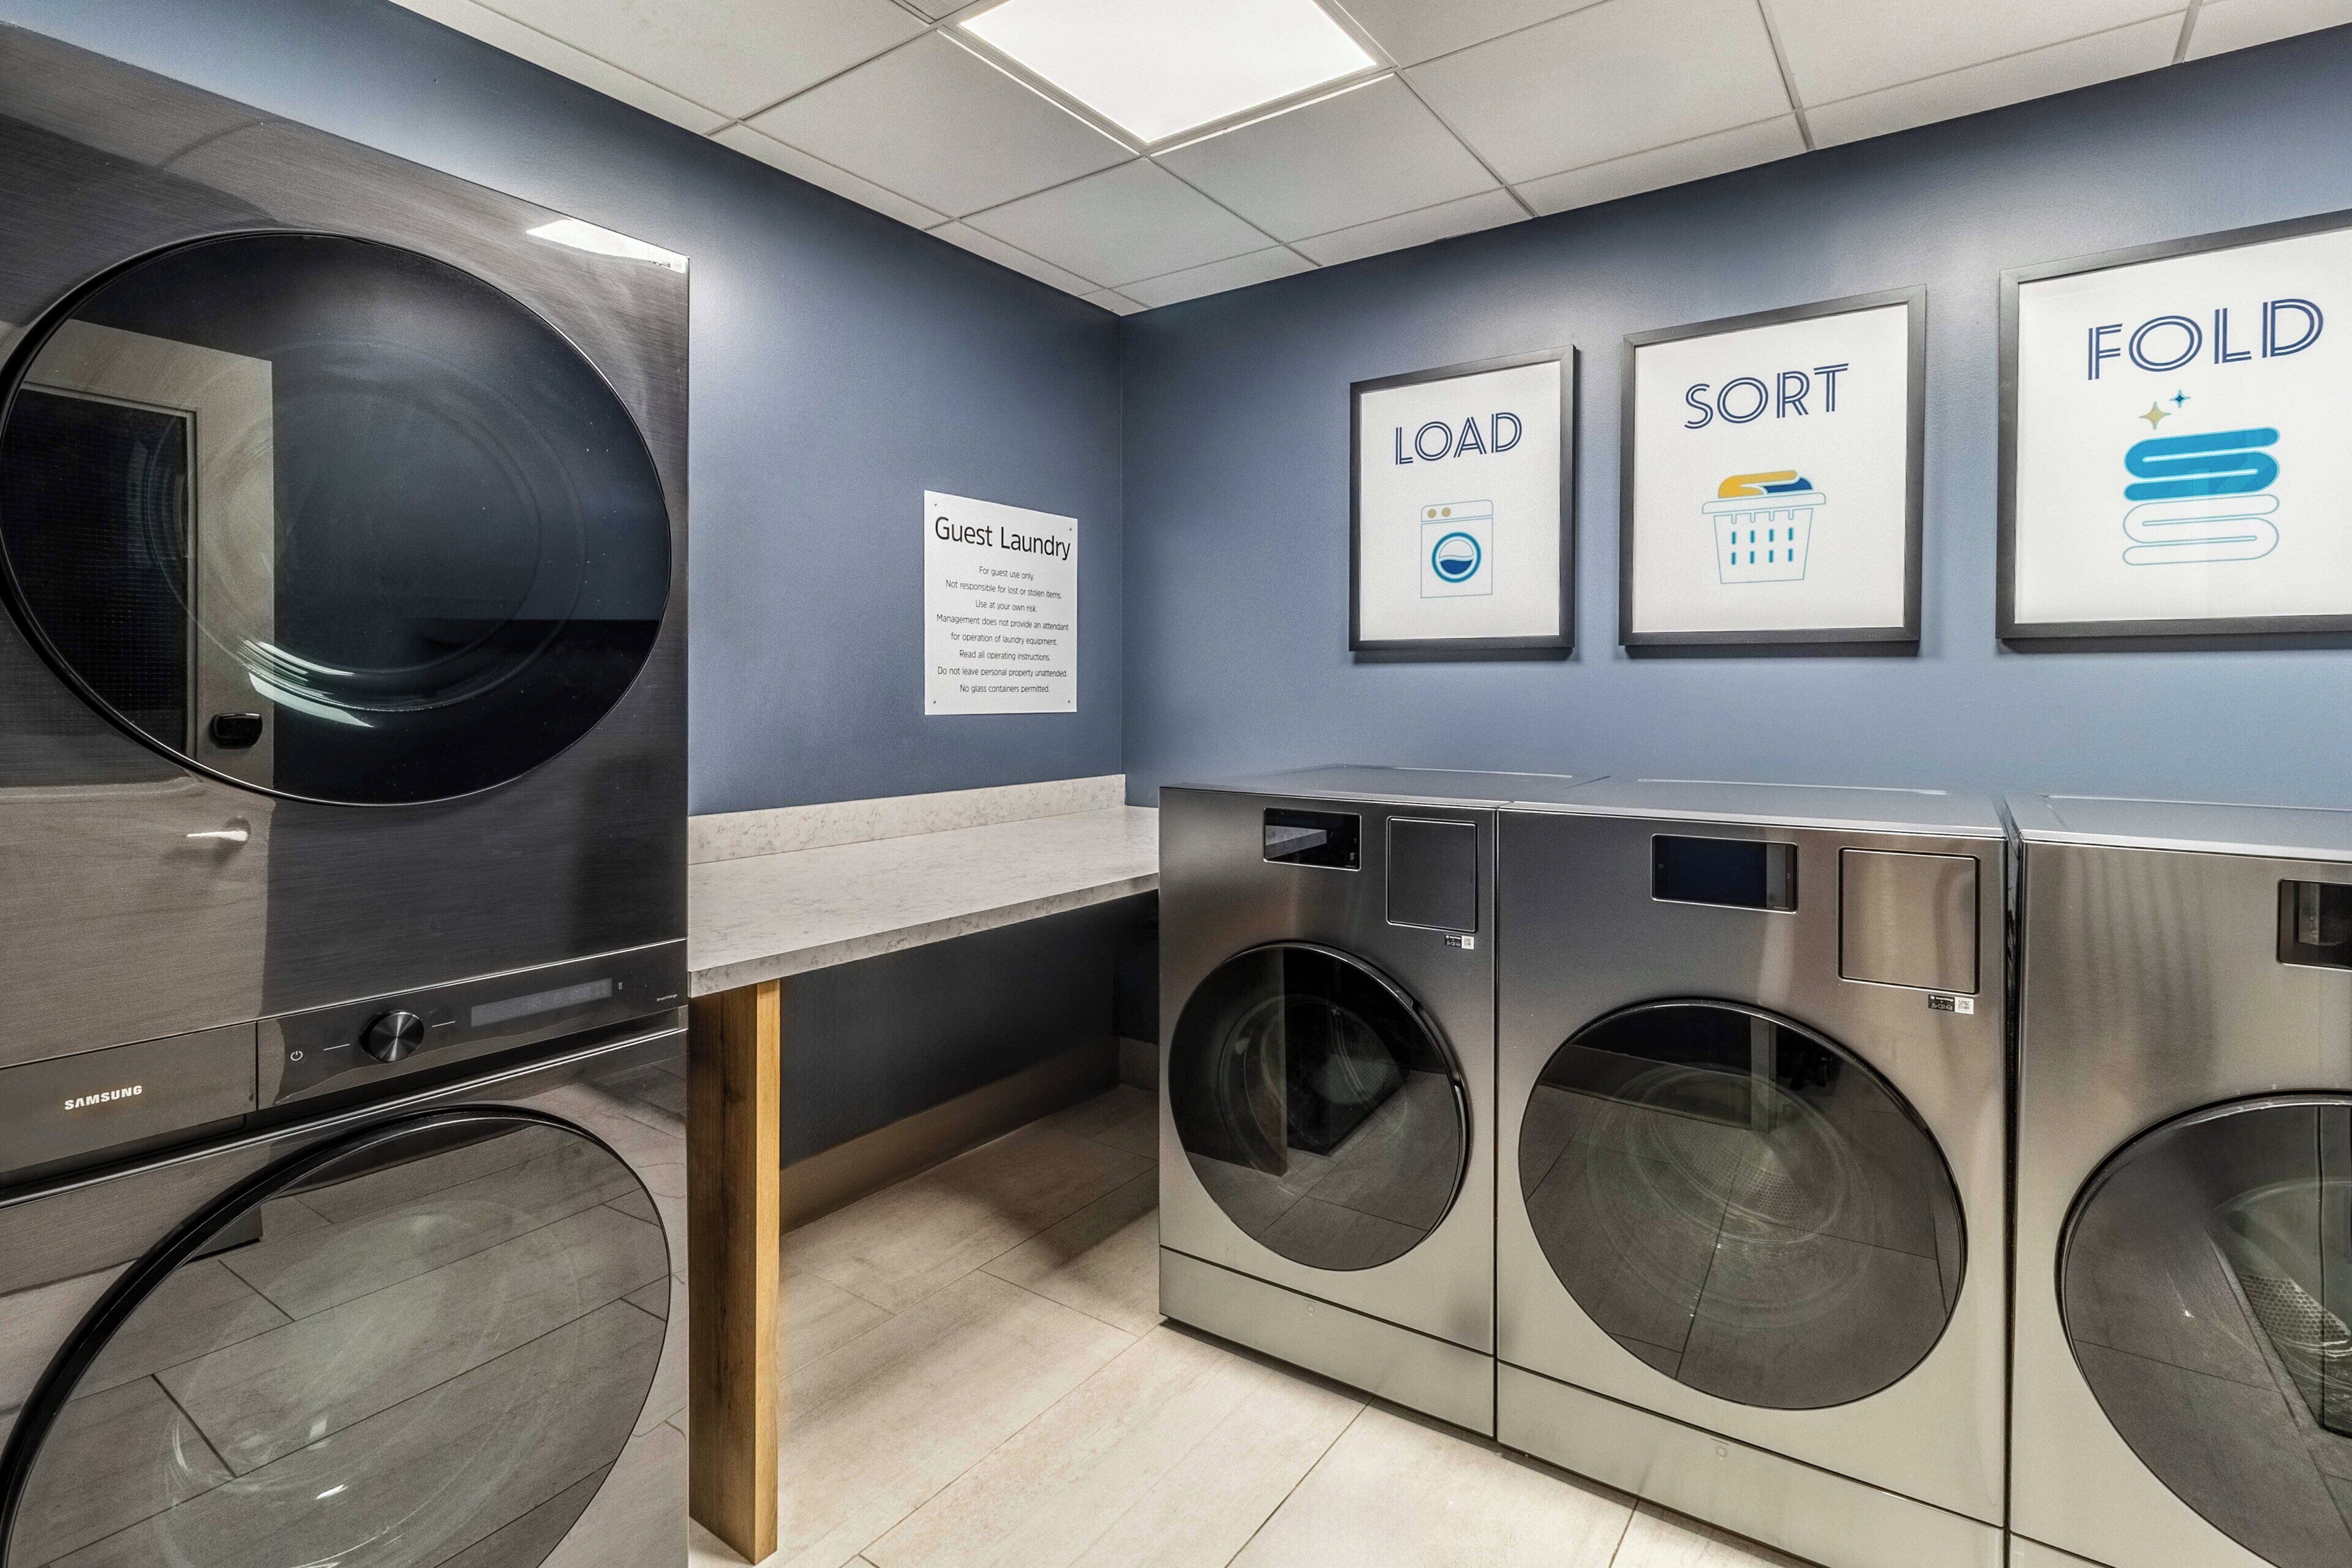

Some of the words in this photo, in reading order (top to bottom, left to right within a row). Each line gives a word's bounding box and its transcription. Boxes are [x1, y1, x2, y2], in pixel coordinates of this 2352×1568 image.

[2089, 300, 2323, 380] FOLD
[1686, 364, 1849, 429] SORT
[1396, 413, 1522, 466] LOAD
[935, 517, 992, 546] Guest
[1001, 527, 1071, 560] Laundry
[960, 583, 995, 592] responsible
[937, 614, 979, 624] Management
[1003, 636, 1024, 644] laundry
[971, 685, 986, 693] glass
[64, 1085, 143, 1110] SAMSUNG
